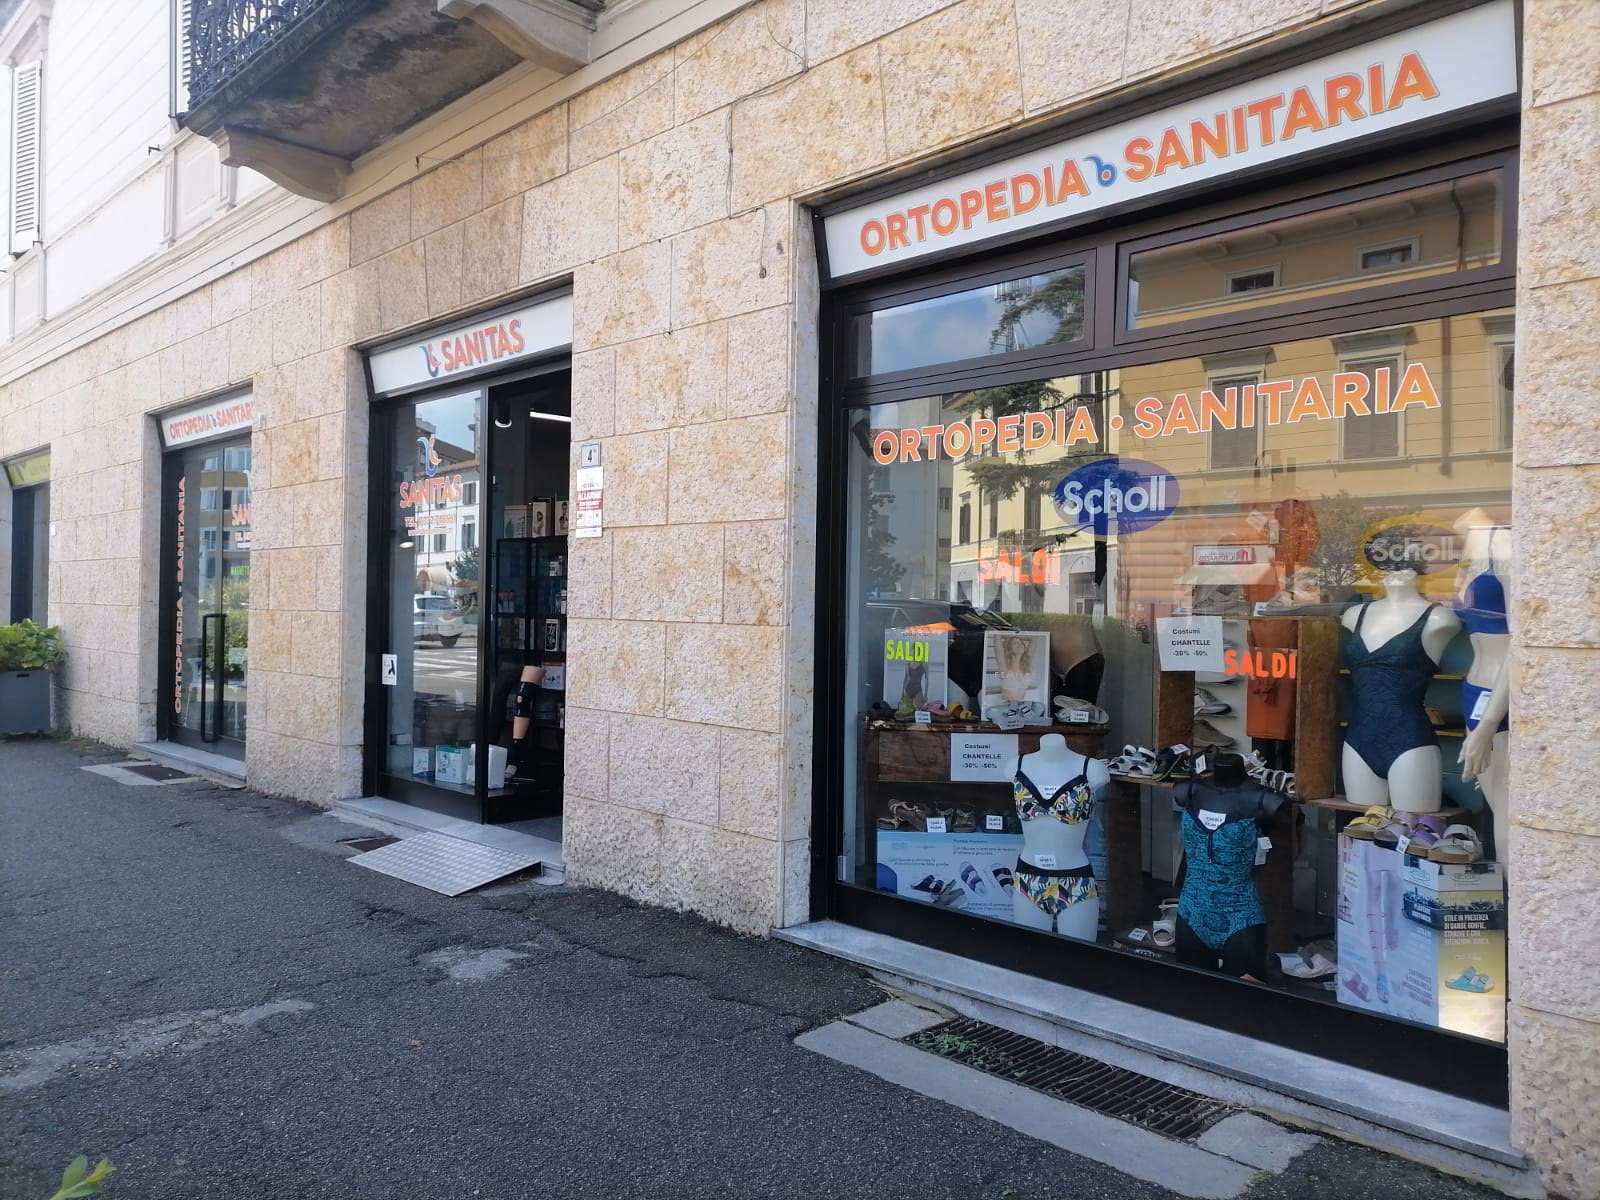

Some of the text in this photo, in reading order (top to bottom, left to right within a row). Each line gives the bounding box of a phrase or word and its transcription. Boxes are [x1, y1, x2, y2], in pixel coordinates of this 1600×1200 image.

[860, 51, 1440, 256] ORTOPEDIA SANITARIA
[442, 318, 525, 373] SANITAS
[169, 413, 213, 440] ORTOPEDIA
[873, 362, 1442, 465] ORTOPEDIA SANITARIA
[400, 474, 462, 509] SANITAS
[1063, 475, 1166, 515] Scholl
[977, 547, 1060, 585] SALDI
[1371, 535, 1454, 562] Scholl
[886, 639, 929, 662] SALDI
[1224, 649, 1297, 680] SALDI
